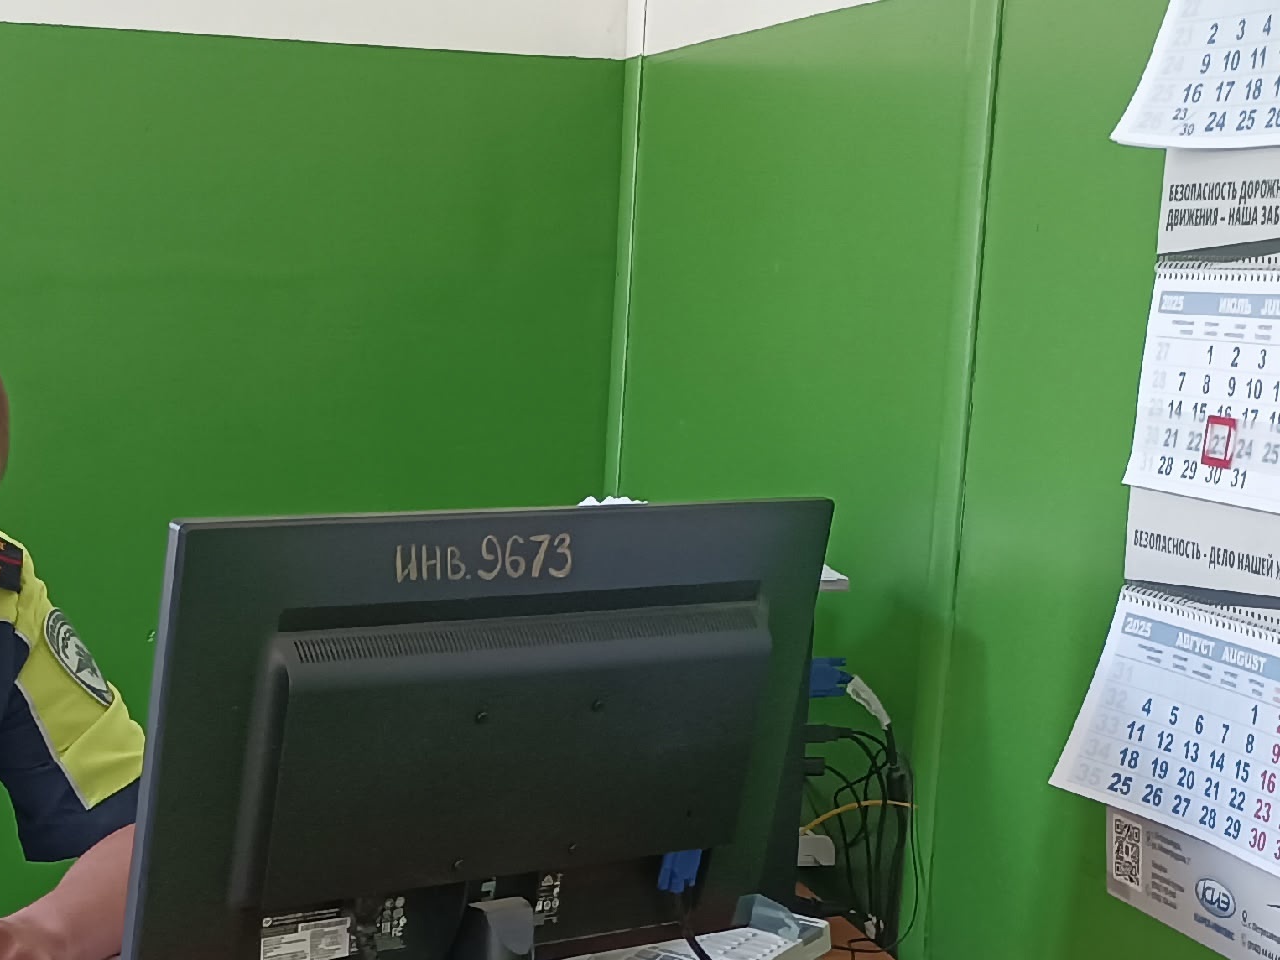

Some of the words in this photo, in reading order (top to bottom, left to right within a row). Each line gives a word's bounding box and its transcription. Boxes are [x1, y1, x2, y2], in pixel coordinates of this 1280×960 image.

[1207, 23, 1218, 44] 2
[1236, 18, 1246, 40] 3
[1263, 14, 1272, 36] 4
[1200, 54, 1211, 74] 9
[1223, 50, 1241, 72] 10
[1251, 46, 1267, 69] 11
[1184, 83, 1203, 103] 16
[1216, 81, 1235, 102] 17
[1245, 78, 1263, 101] 18
[1205, 111, 1227, 132] 24
[1236, 109, 1257, 131] 25
[1169, 181, 1237, 202] БЕЗОПАСНОСТЬ
[1166, 207, 1219, 231] ДВИЖЕНИЯ
[1228, 206, 1258, 226] НАША
[1207, 345, 1213, 365] 1
[1231, 346, 1241, 368] 2
[1258, 349, 1267, 369] 3
[1179, 371, 1186, 392] 7
[1203, 374, 1210, 394] 8
[1228, 377, 1236, 397] 9
[1246, 378, 1263, 399] 10
[1168, 399, 1182, 419] 14
[1192, 402, 1207, 423] 15
[1217, 404, 1232, 418] 16
[1242, 408, 1259, 429] 17
[1270, 411, 1280, 433] 1
[1163, 428, 1179, 448] 21
[1186, 431, 1202, 452] 22
[1236, 439, 1253, 459] 24
[1262, 442, 1280, 464] 25
[1158, 456, 1174, 476] 28
[1180, 460, 1198, 480] 29
[1205, 466, 1222, 484] 30
[1231, 468, 1247, 489] 31
[1133, 529, 1201, 560] БЕЗОПАСНОСТЬ
[1208, 546, 1235, 569] ДЕЛО
[1237, 553, 1273, 578] НАШЕЙ
[1124, 617, 1152, 638] 2025
[1175, 632, 1215, 657] АВГУСТ
[1221, 646, 1267, 673] AUGUST
[1141, 698, 1153, 717] 4
[1169, 706, 1179, 725] 5
[1195, 714, 1204, 735] 6
[1221, 723, 1230, 743] 7
[1246, 733, 1255, 754] 8
[1251, 704, 1258, 725] 1
[1126, 720, 1145, 742] 11
[1157, 730, 1174, 752] 12
[1184, 740, 1200, 762] 13
[1209, 749, 1225, 772] 14
[1235, 759, 1251, 783] 15
[1260, 769, 1276, 794] 16
[1119, 747, 1140, 769] 18
[1151, 757, 1169, 779] 19
[1177, 766, 1195, 790] 20
[1204, 777, 1220, 800] 21
[1228, 787, 1246, 812] 22
[1253, 798, 1271, 823] 23
[1107, 772, 1133, 795] 25
[1141, 784, 1163, 806] 26
[1171, 794, 1191, 817] 27
[1199, 805, 1216, 829] 28
[1224, 816, 1241, 840] 29
[1249, 828, 1266, 851] 30
